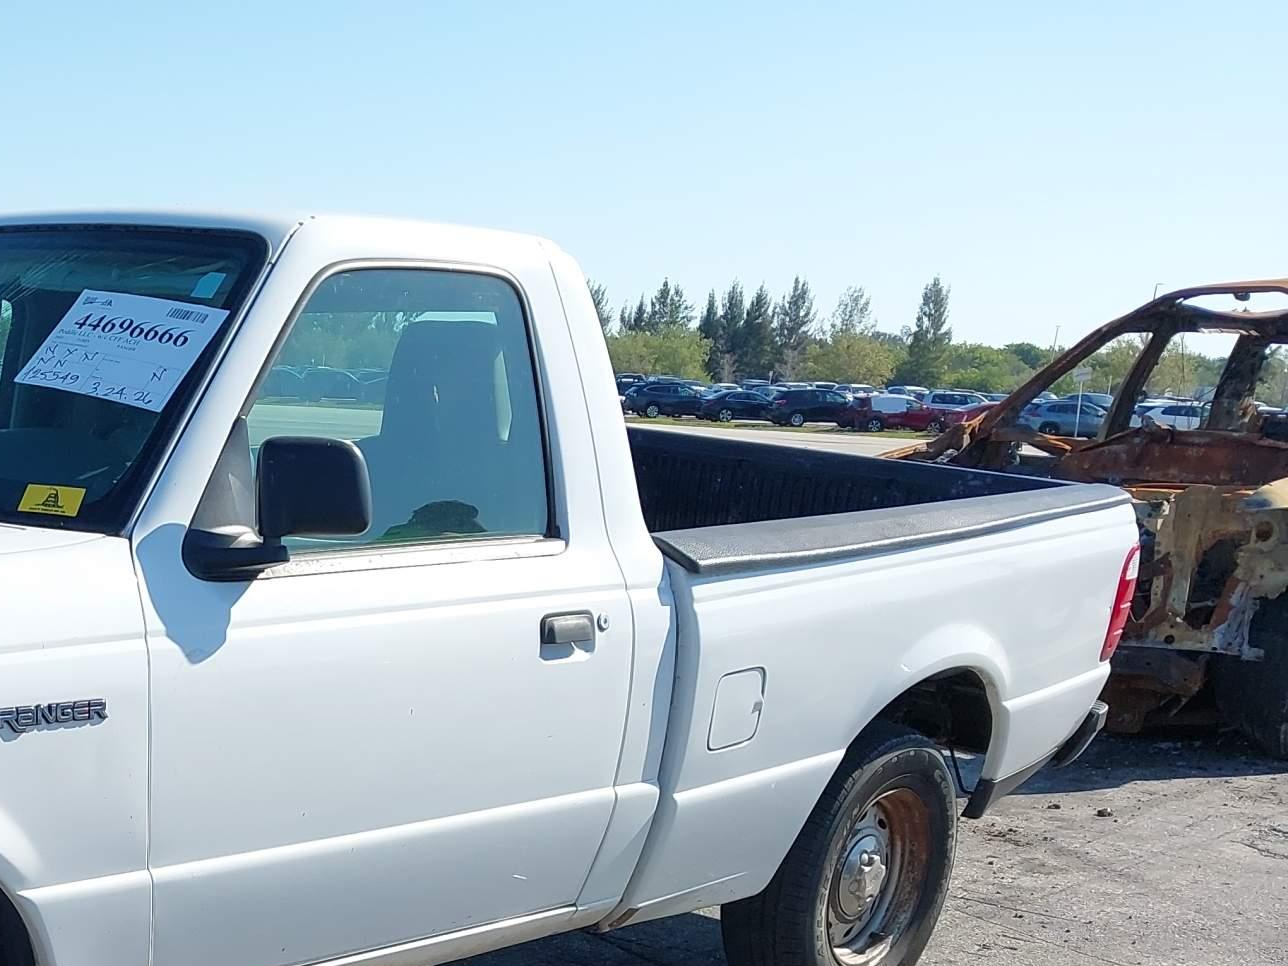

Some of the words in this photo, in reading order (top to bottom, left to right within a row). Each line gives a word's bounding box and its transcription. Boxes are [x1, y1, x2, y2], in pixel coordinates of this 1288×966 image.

[74, 313, 196, 347] 44696666
[64, 348, 78, 359] Y
[151, 368, 168, 381] N
